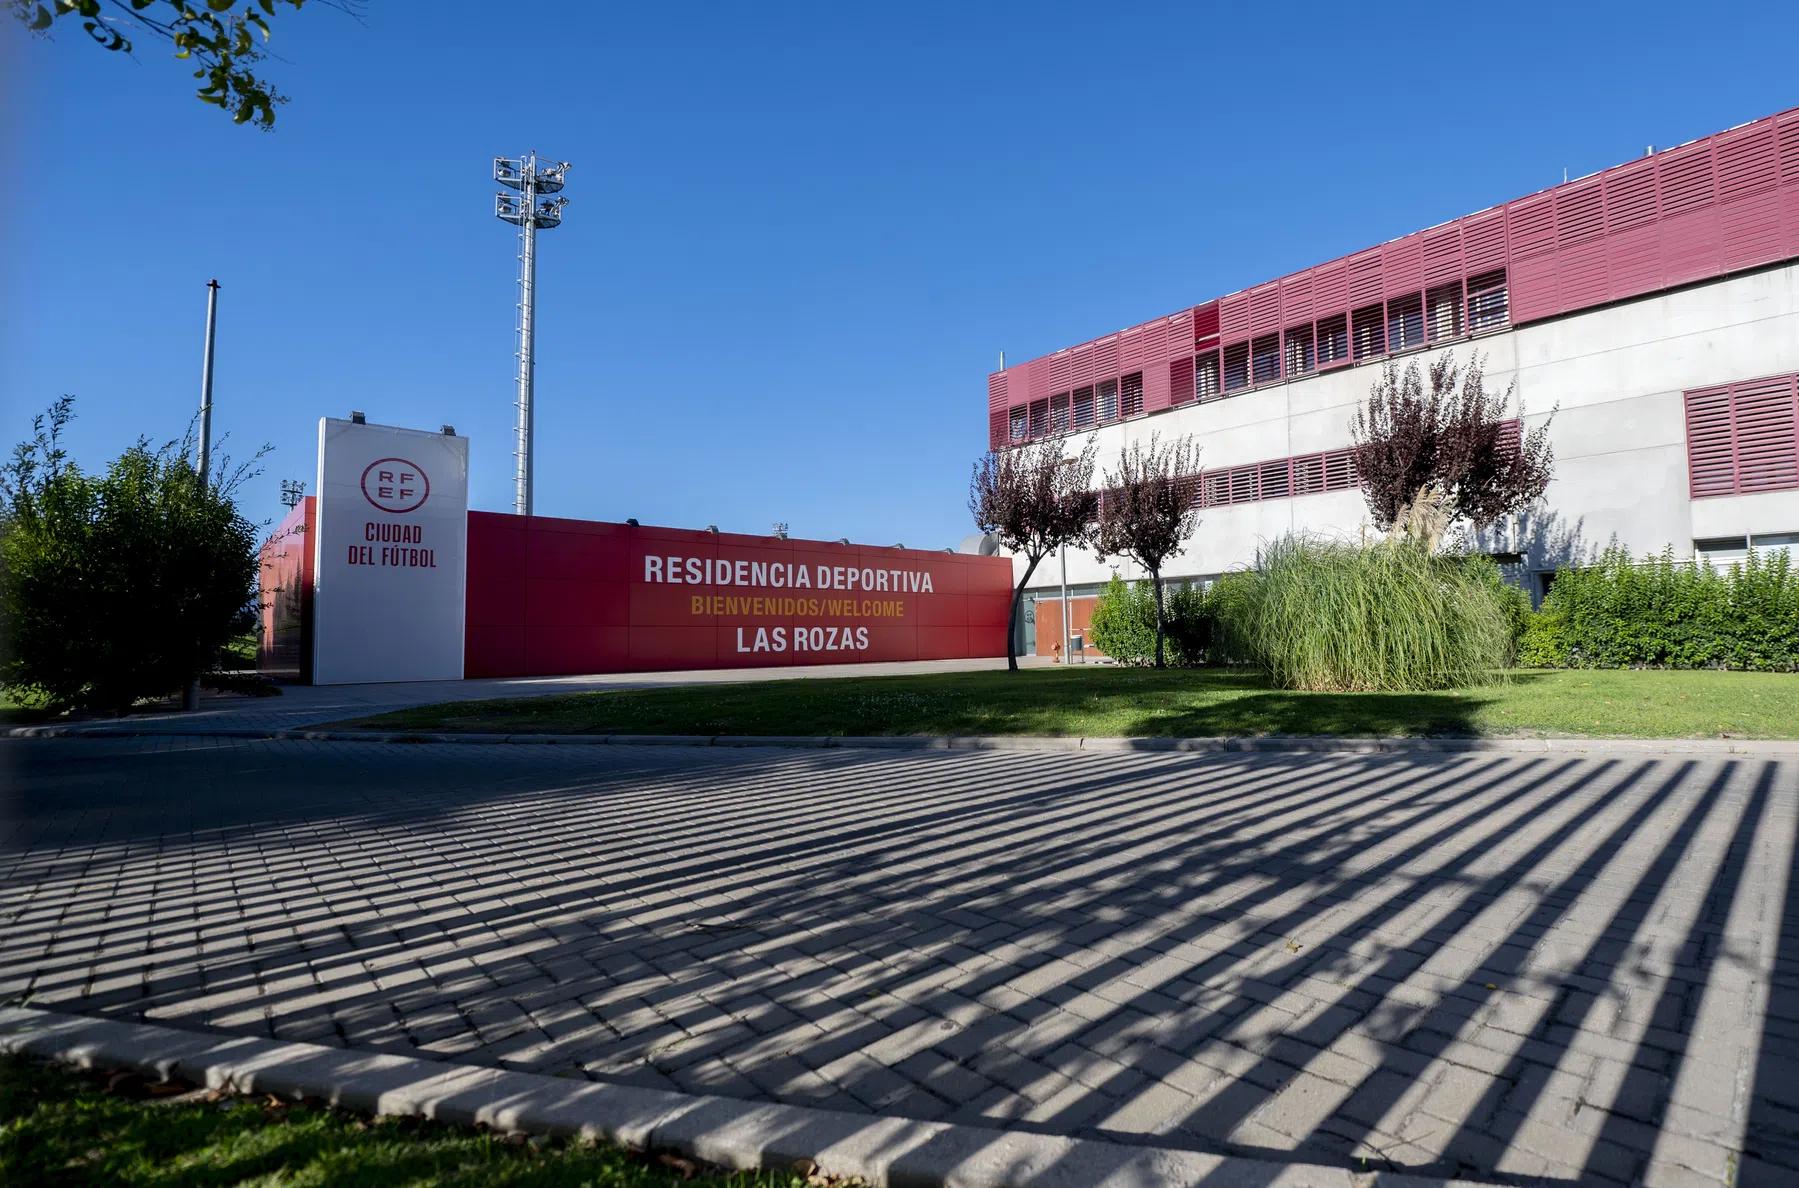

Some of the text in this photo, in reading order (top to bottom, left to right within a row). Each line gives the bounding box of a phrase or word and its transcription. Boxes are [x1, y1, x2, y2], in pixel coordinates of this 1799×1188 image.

[365, 522, 422, 544] CIUDAD
[348, 545, 437, 568] DEL FÚTBOL
[645, 555, 934, 594] RESIDENCIA DEPORTIVA
[691, 595, 905, 618] BIENVENIDOS/WELCOME
[736, 626, 869, 653] LAS ROZAS
